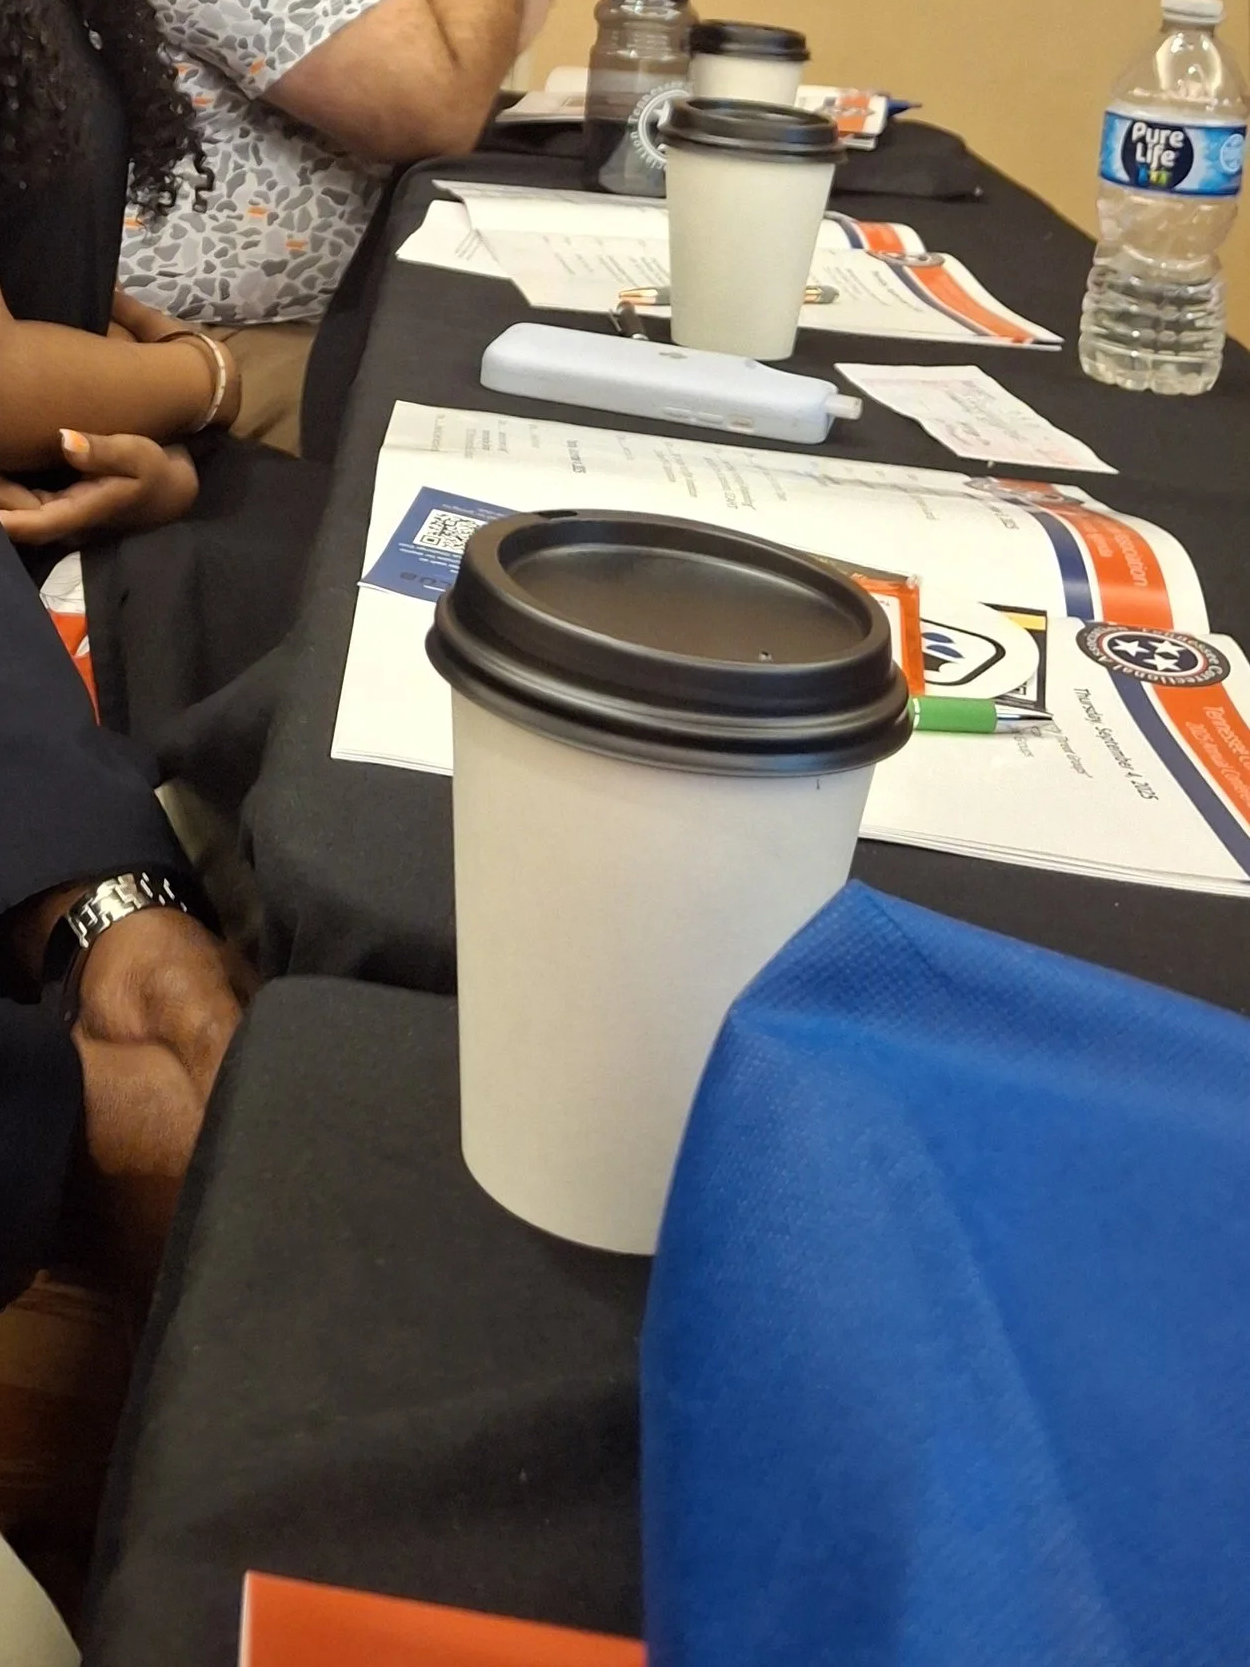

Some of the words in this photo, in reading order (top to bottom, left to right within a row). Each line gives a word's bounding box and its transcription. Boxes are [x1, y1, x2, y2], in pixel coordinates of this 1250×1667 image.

[1131, 121, 1185, 148] Pure
[1136, 141, 1177, 171] Life
[1113, 665, 1223, 685] Correctional
[1202, 706, 1250, 755] Tennessee
[1095, 726, 1134, 772] September
[1131, 780, 1159, 801] 2025
